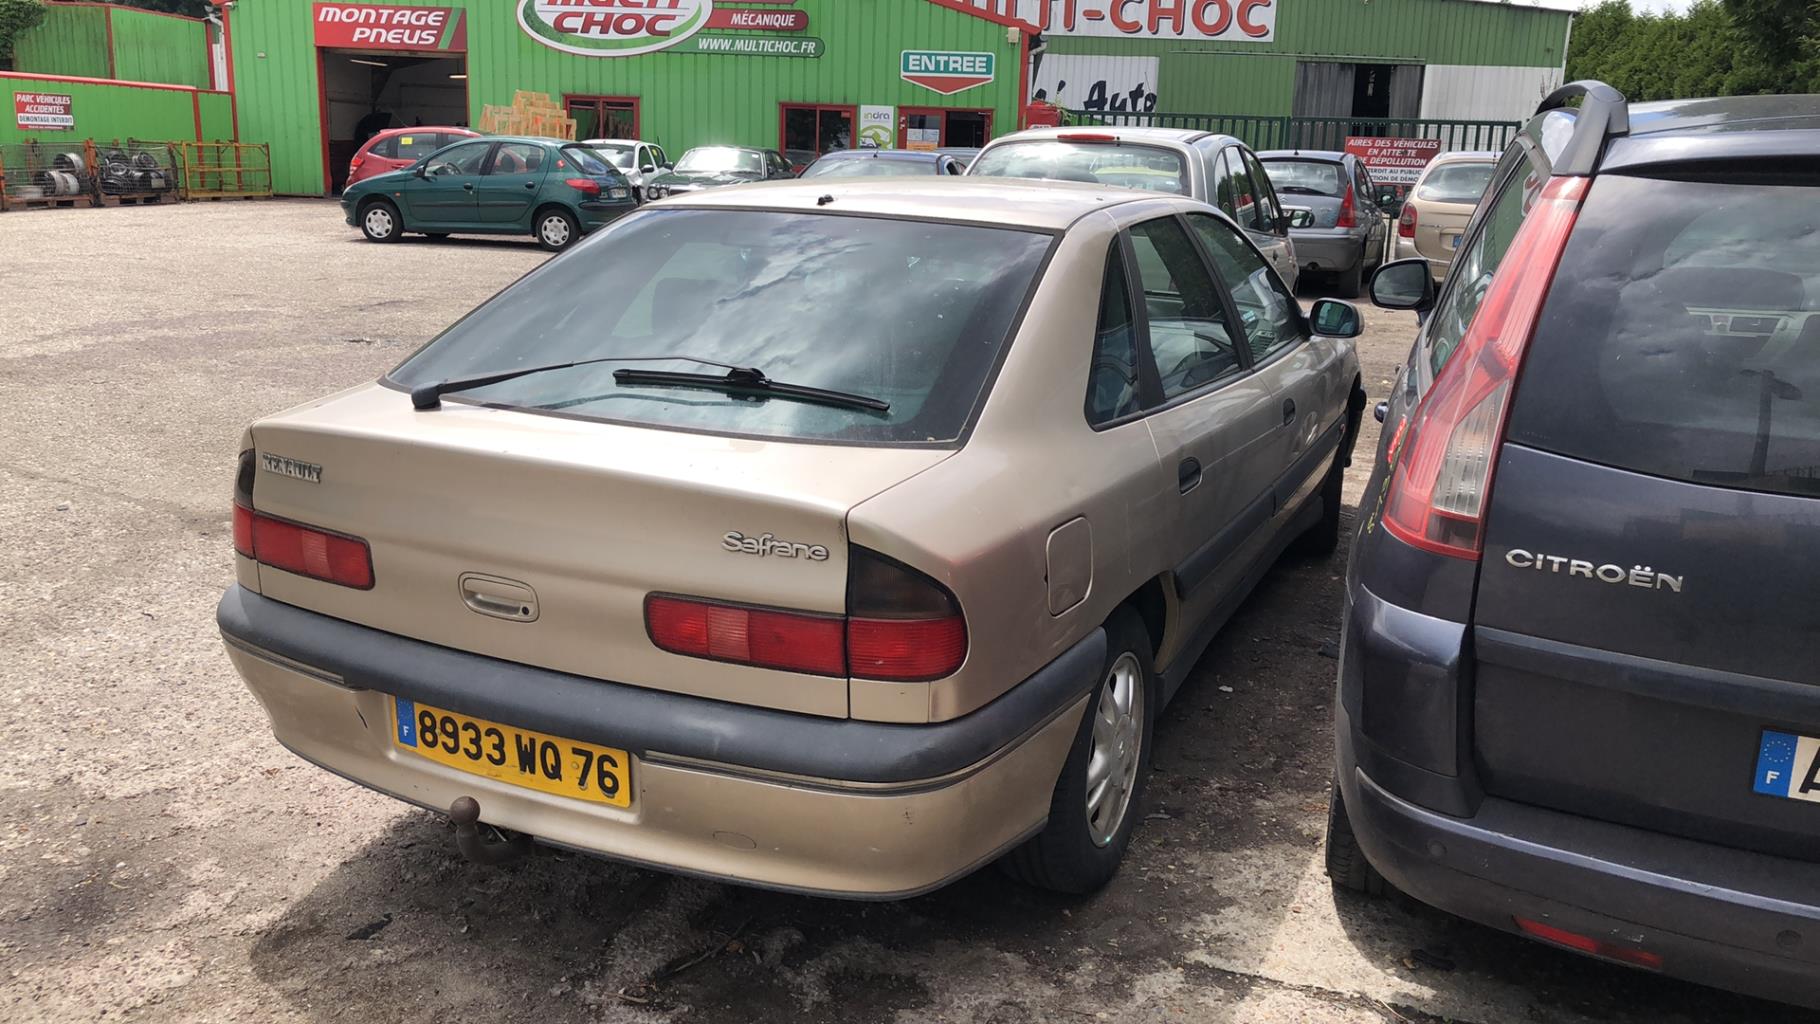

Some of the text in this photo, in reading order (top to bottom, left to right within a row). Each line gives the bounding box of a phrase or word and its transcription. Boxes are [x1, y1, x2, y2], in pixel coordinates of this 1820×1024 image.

[318, 7, 445, 26] MONTAGE
[552, 11, 677, 37] CHOC
[730, 10, 796, 28] MÉCANIQUE
[351, 27, 438, 45] PNEUS
[698, 38, 816, 54] WWW.MULTICHOC.FR
[908, 54, 987, 72] ENTREE
[16, 94, 35, 103] PARC
[864, 111, 890, 120] indra
[1347, 139, 1373, 147] AIRES
[1394, 138, 1438, 148] VÉHICULES
[1380, 148, 1417, 157] ATTETE
[262, 452, 321, 483] RENAULT
[721, 530, 830, 561] Safrane
[1505, 548, 1684, 593] CITROËN
[403, 710, 620, 796] F 8933 WQ 76
[1766, 770, 1780, 784] F
